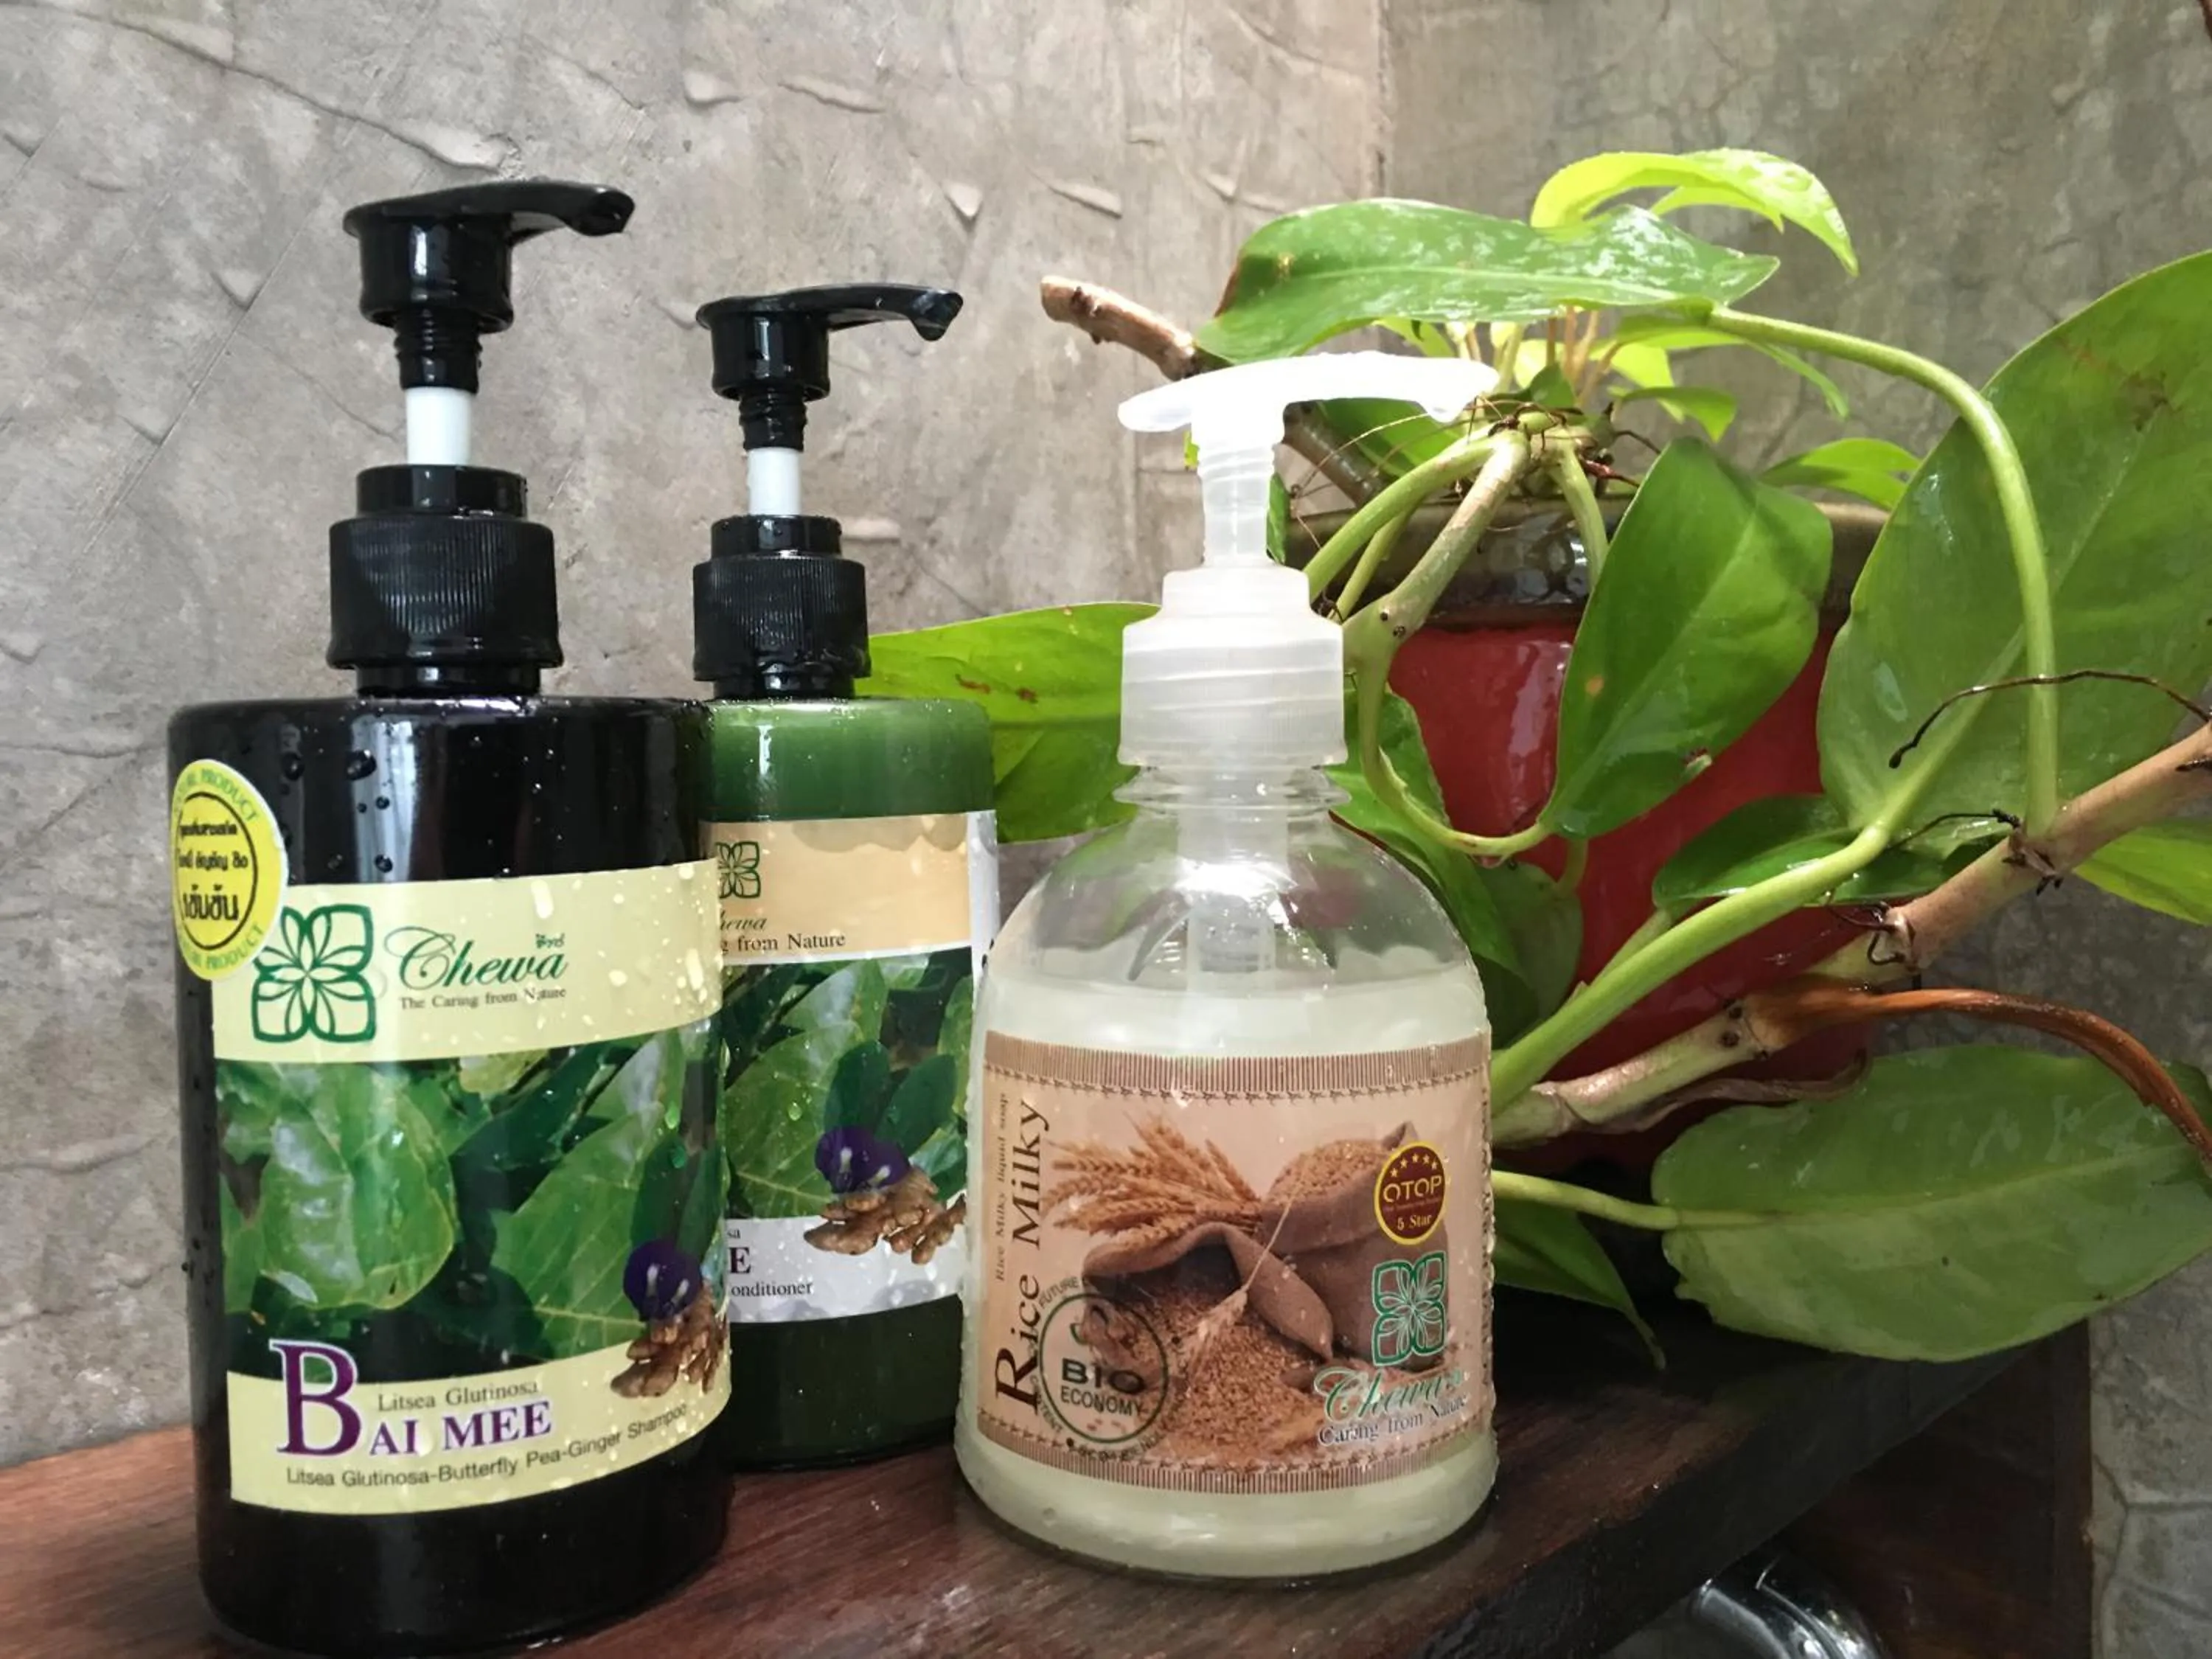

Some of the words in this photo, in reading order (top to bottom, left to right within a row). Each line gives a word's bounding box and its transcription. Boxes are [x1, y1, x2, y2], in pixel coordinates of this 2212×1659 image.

[720, 909, 768, 931] hewa
[383, 925, 568, 991] Chewa
[737, 935, 779, 952] from
[787, 933, 846, 950] Nature
[400, 997, 425, 1009] The
[432, 995, 479, 1009] Caring
[485, 991, 517, 1005] from
[524, 987, 566, 1001] Nature
[1012, 1099, 1050, 1250] Milky
[1383, 1175, 1442, 1203] OTOP
[1397, 1217, 1405, 1231] 5
[1409, 1214, 1432, 1229] Star
[731, 1280, 813, 1297] onditioner
[1039, 1276, 1079, 1309] FUTURE
[995, 1275, 1040, 1416] Rice
[1062, 1357, 1147, 1395] BIO
[378, 1394, 436, 1411] Litsea
[445, 1381, 538, 1405] Glutinosa
[1060, 1385, 1144, 1417] ECONOMY
[442, 1401, 552, 1451] MEE
[1319, 1423, 1379, 1445] Caring
[1388, 1412, 1423, 1434] from
[287, 1467, 335, 1486] Litsea
[342, 1455, 518, 1486] Glutinosa-Butterfly
[526, 1432, 622, 1467] Pea-Ginger
[628, 1403, 687, 1439] Shampoo
